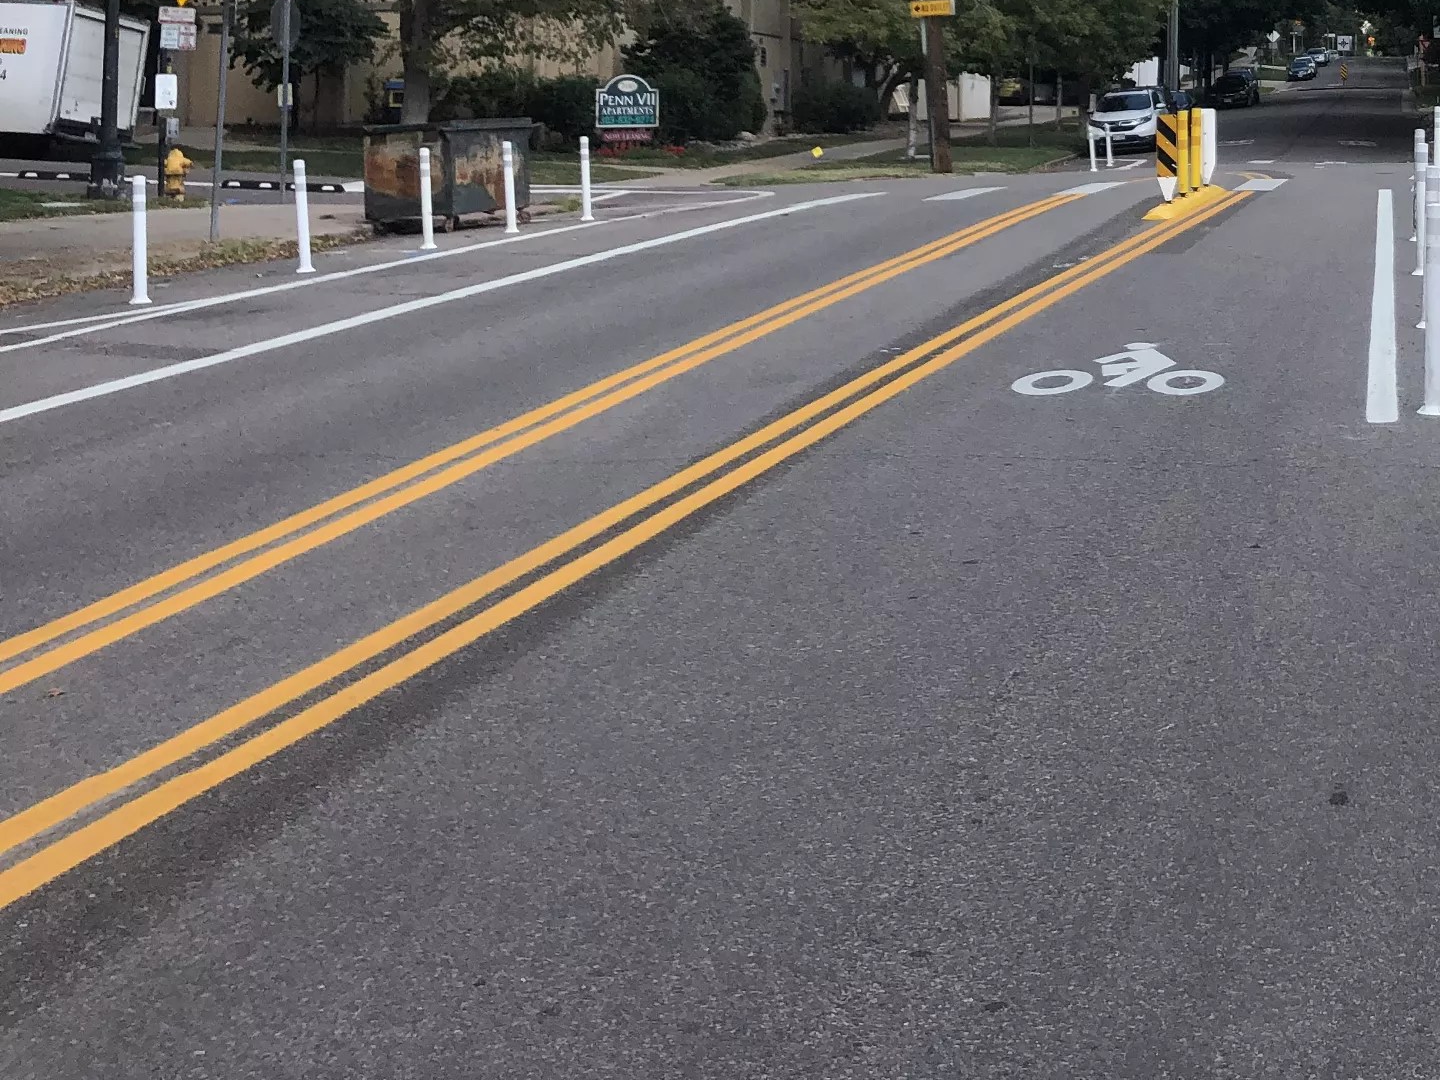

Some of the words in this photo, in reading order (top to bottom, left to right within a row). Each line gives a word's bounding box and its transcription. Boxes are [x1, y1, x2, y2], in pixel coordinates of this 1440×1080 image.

[599, 93, 634, 106] PENN
[635, 92, 656, 106] VII
[601, 107, 654, 115] APARTMENTS
